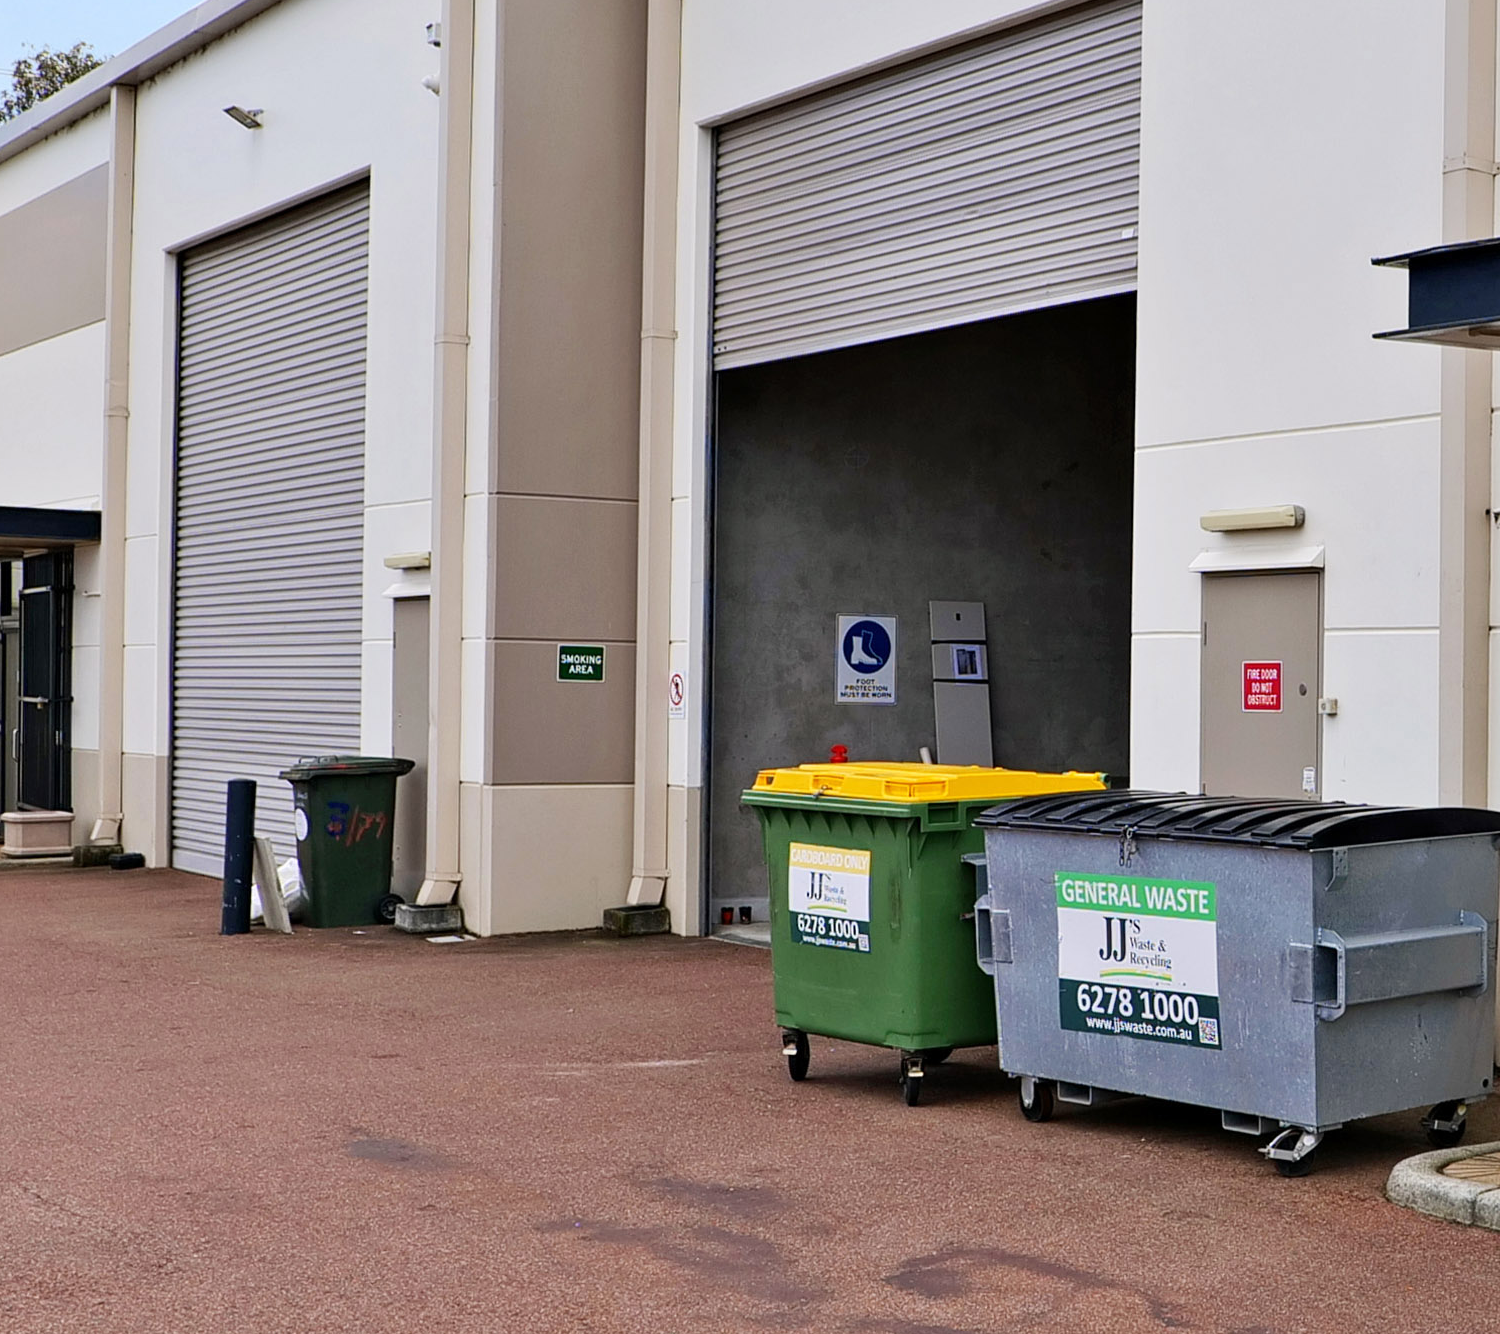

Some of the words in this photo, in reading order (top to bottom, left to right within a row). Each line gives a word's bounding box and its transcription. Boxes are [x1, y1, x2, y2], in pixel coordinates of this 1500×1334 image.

[561, 654, 602, 665] SMOKING
[569, 665, 594, 674] AREA
[1247, 669, 1260, 680] FIRE
[1261, 669, 1277, 680] DOOR
[1252, 682, 1260, 693] DO
[1261, 682, 1273, 693] NOT
[1247, 694, 1277, 706] OBSTRUCT
[792, 848, 843, 868] CARDBOARD
[844, 854, 869, 870] ONLY
[1062, 879, 1141, 909] GENERAL
[1144, 885, 1209, 914] WASTE
[797, 913, 826, 935] 6278
[828, 918, 859, 940] 1000
[1099, 916, 1141, 962] JJ'S
[1130, 936, 1156, 952] Waste
[1157, 939, 1167, 953] &
[1130, 951, 1173, 969] Recycling
[1076, 982, 1134, 1018] 6278
[1139, 990, 1200, 1026] 1000
[1086, 1016, 1193, 1041] www.jjswaste.com.au
